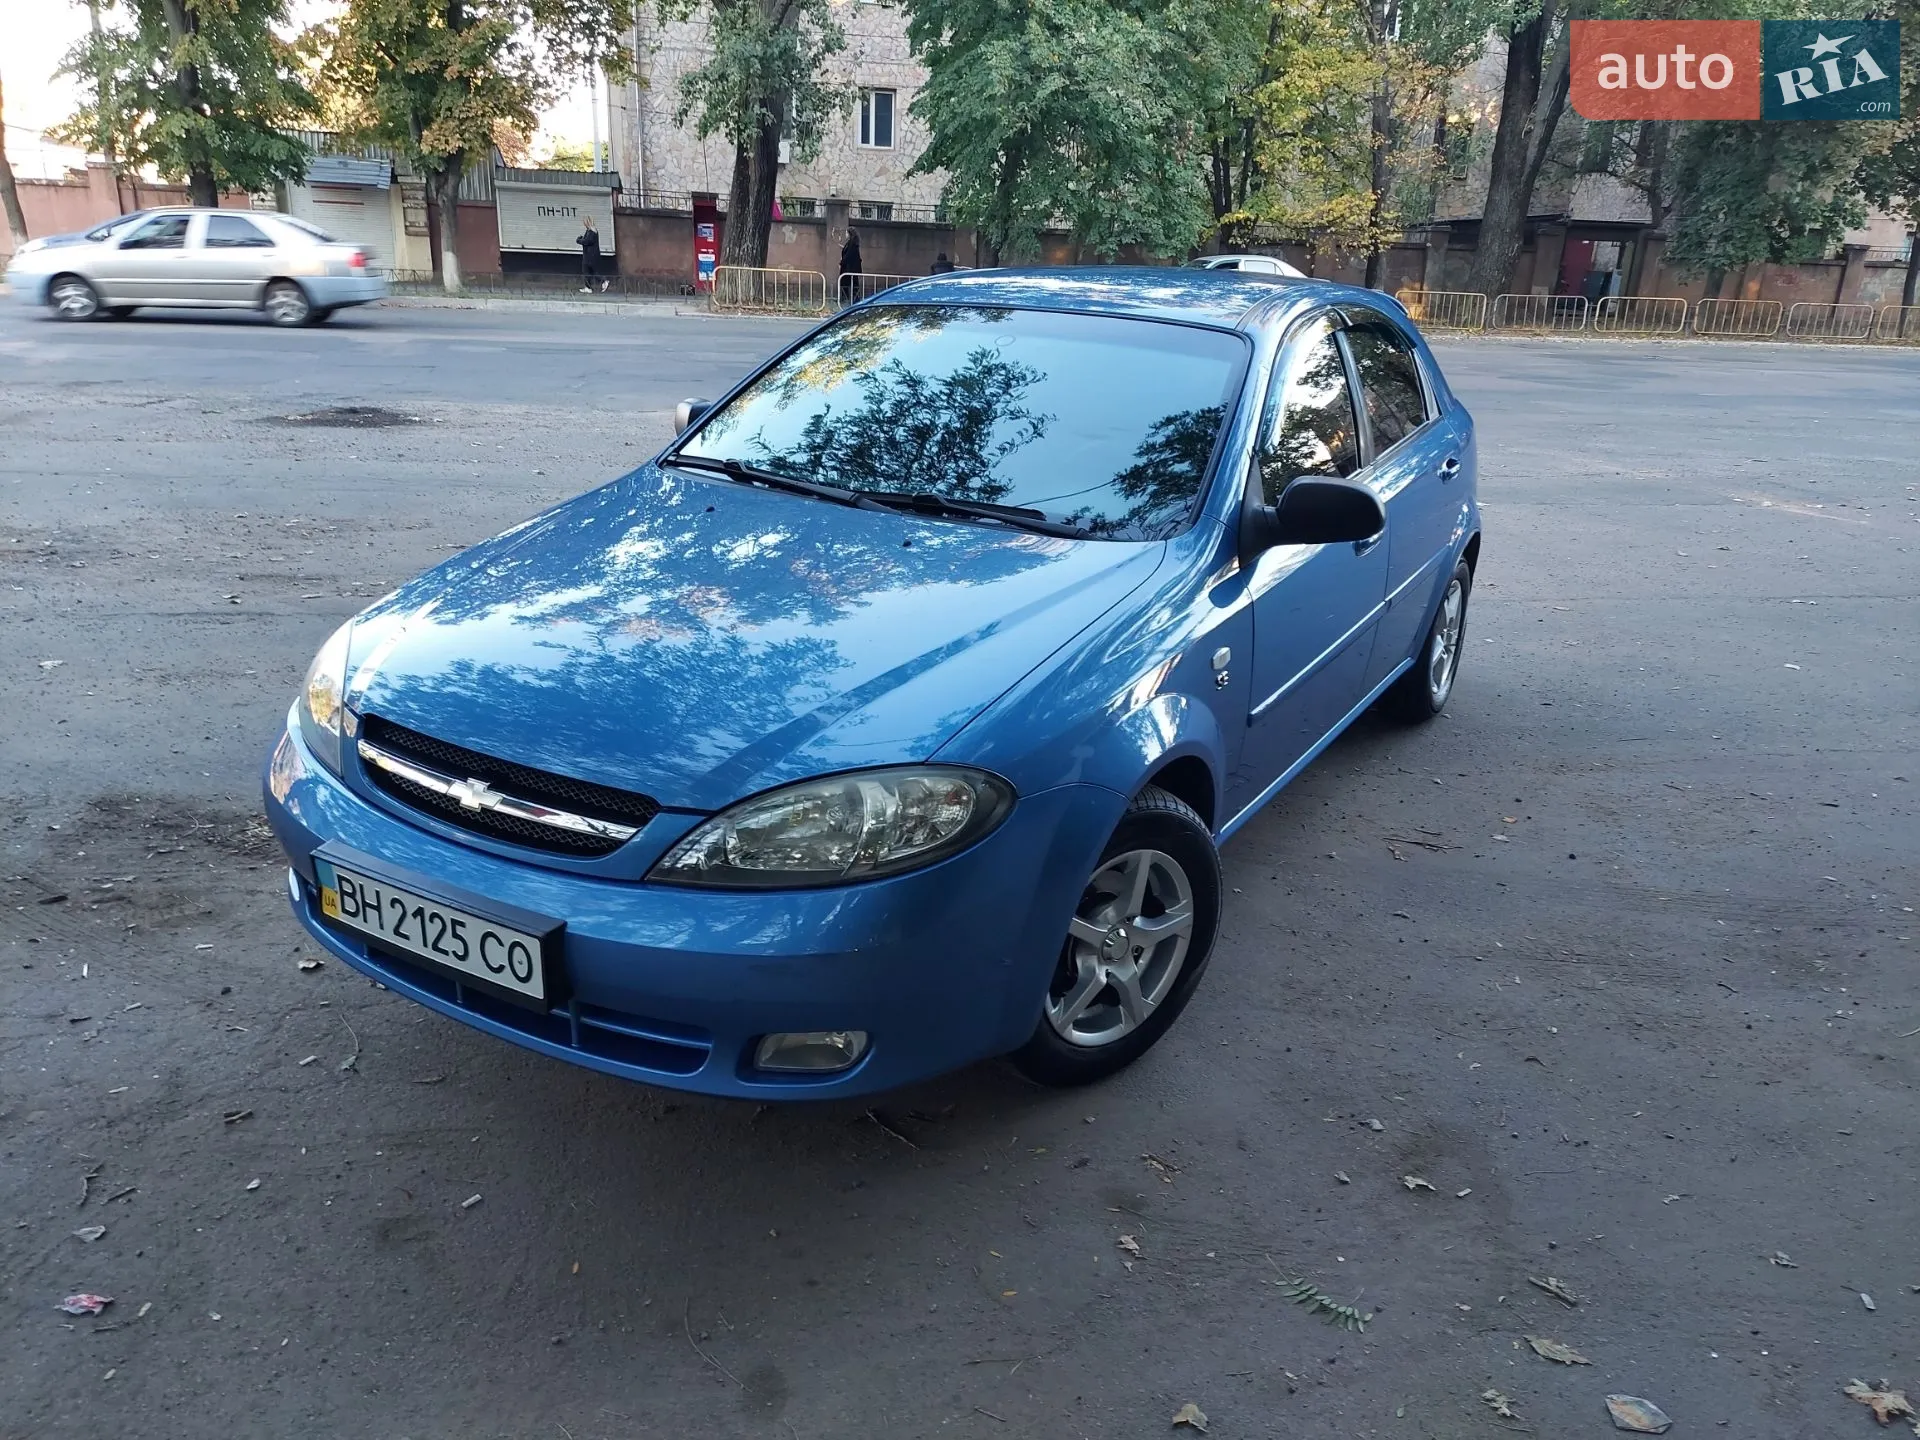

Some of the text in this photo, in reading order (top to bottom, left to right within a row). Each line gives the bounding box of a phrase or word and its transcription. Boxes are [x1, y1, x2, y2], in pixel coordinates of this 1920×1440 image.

[537, 206, 578, 217] ПН-ПТ
[324, 895, 337, 910] UA
[336, 873, 533, 984] BH 2125 CO
